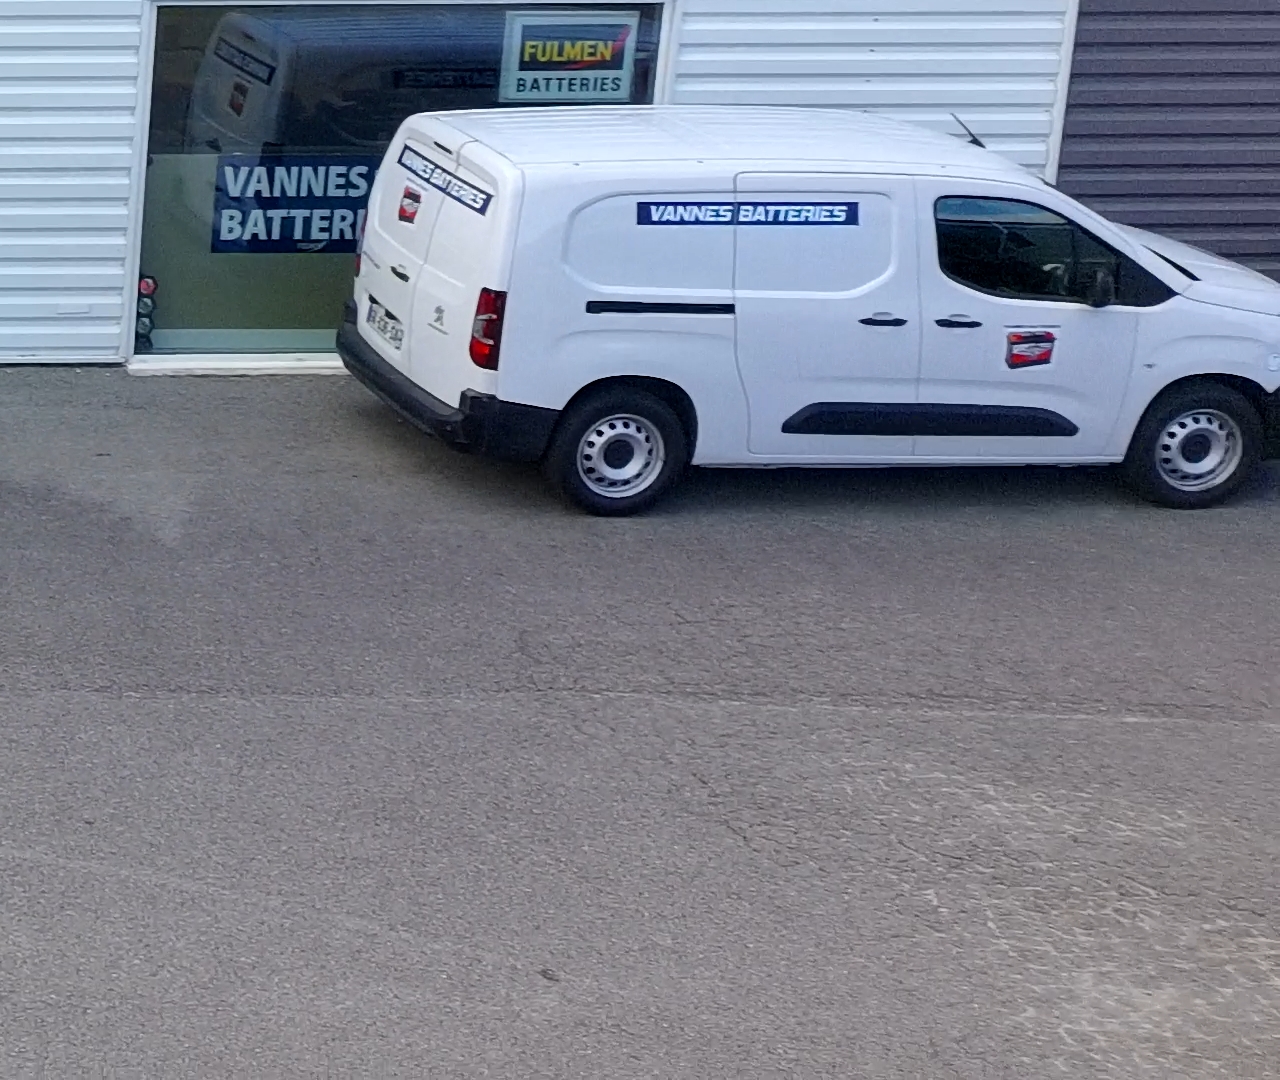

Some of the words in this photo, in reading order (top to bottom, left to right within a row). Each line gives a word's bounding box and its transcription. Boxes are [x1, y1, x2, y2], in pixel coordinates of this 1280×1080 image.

[523, 40, 614, 62] FULMEN
[516, 77, 622, 92] BATTERIES
[224, 166, 369, 197] VANNES
[219, 209, 366, 240] BATTERI
[650, 205, 733, 222] VANNES
[738, 205, 848, 222] BATTERIES
